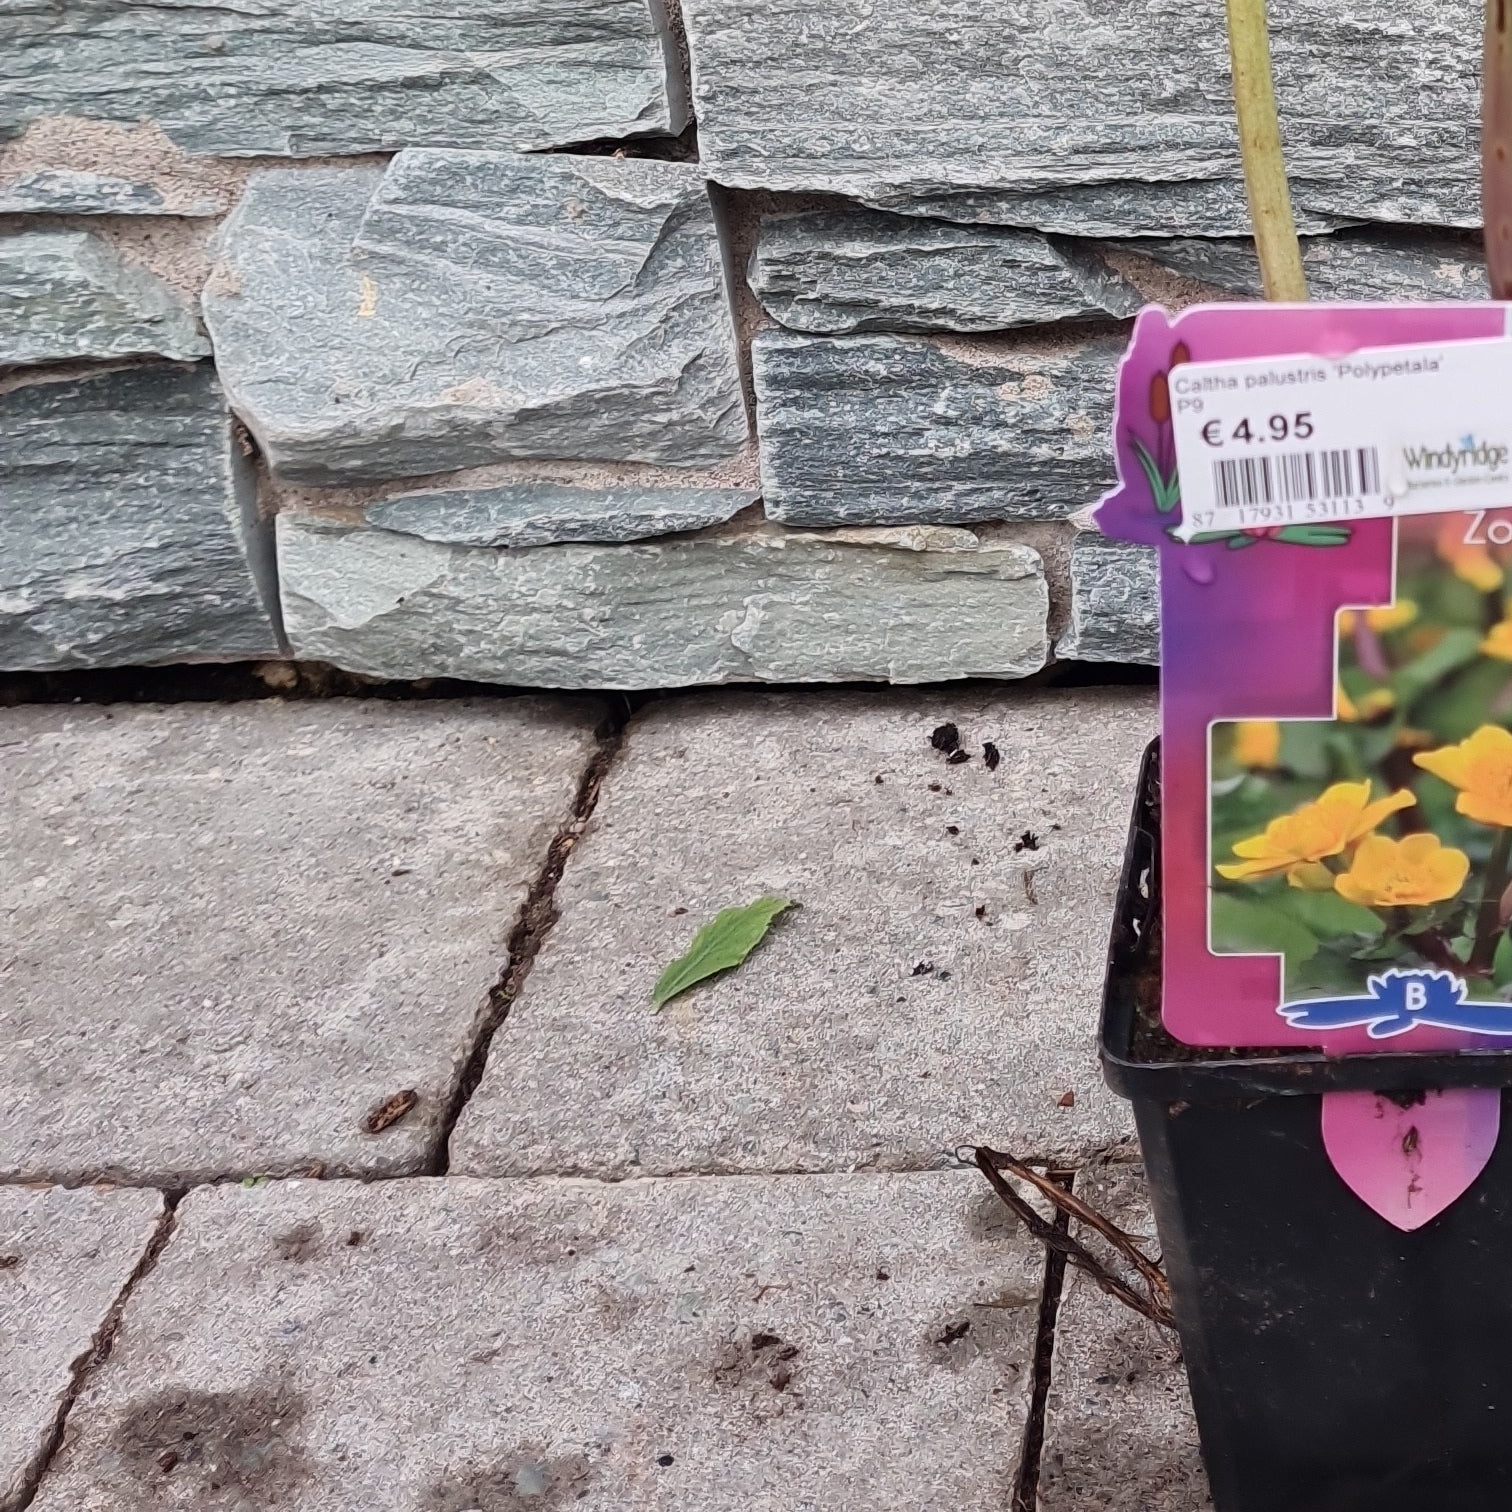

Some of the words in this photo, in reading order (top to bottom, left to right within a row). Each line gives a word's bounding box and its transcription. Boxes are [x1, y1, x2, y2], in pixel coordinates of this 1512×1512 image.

[1174, 373, 1238, 395] Caltha
[1244, 366, 1327, 390] palustris
[1403, 439, 1509, 473] Windyridge
[1405, 982, 1427, 1010] B
